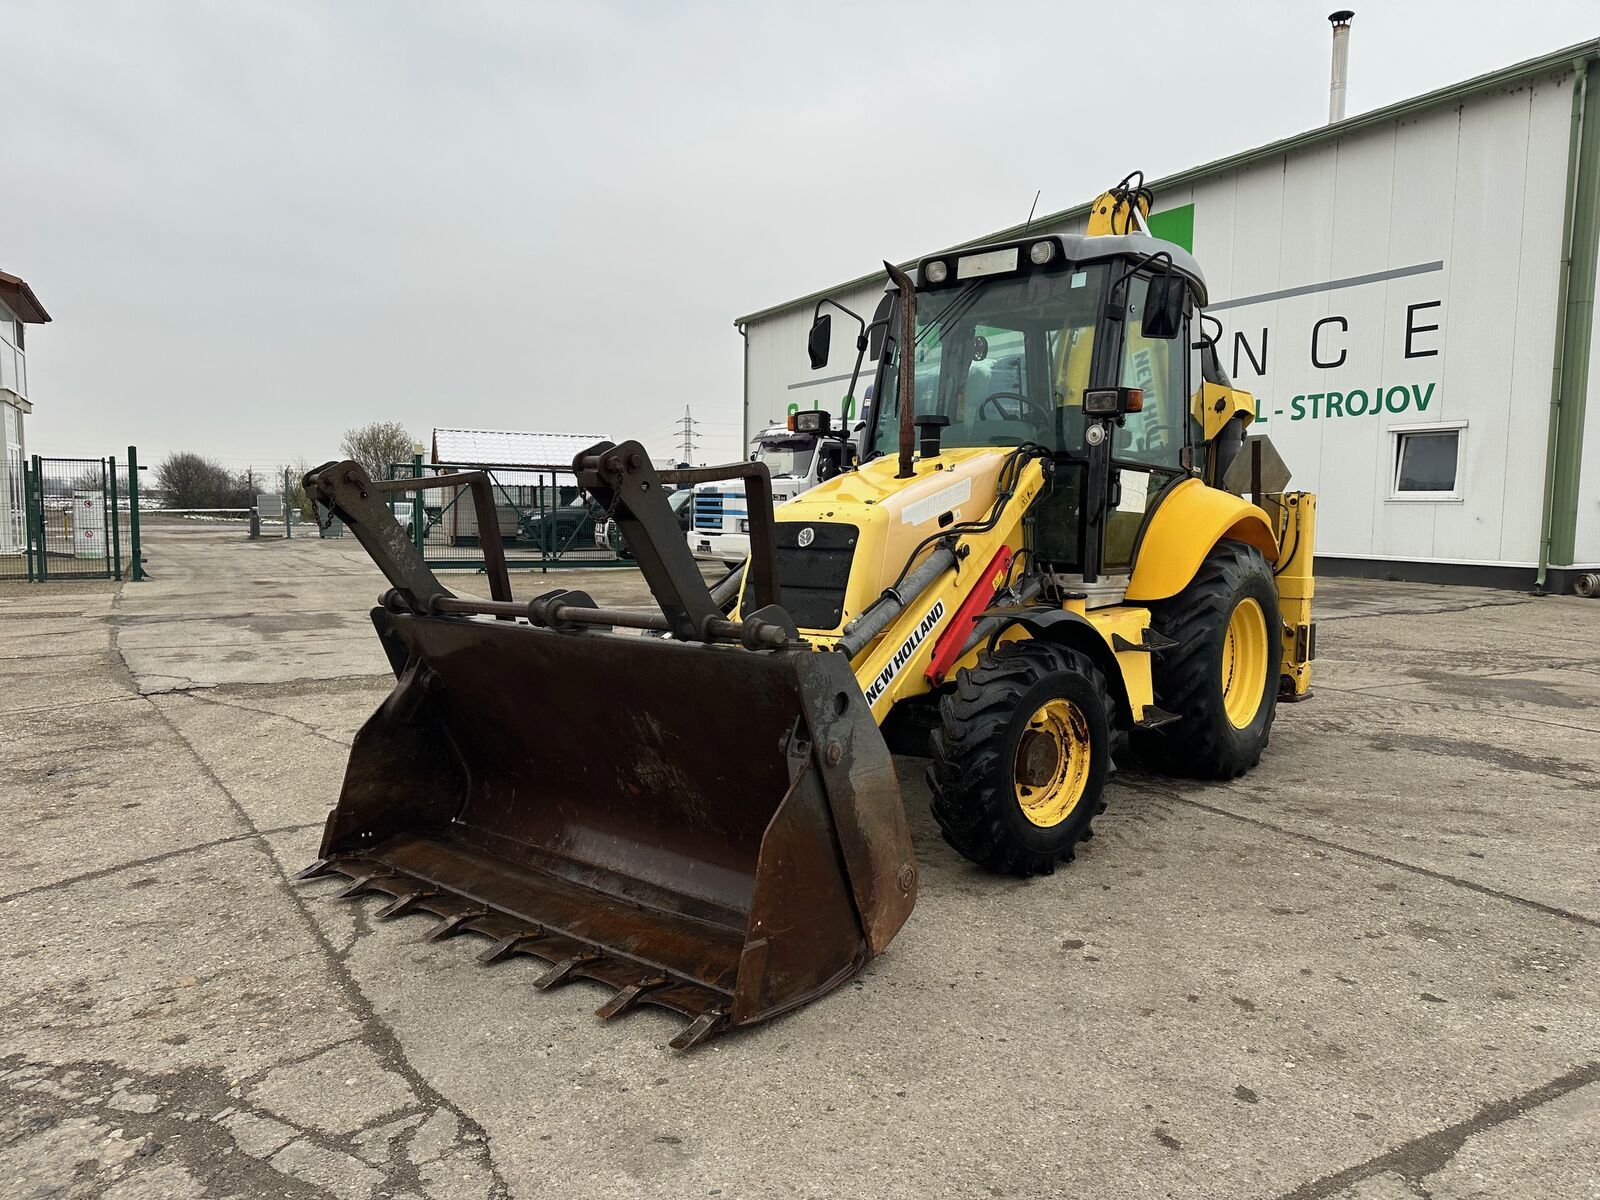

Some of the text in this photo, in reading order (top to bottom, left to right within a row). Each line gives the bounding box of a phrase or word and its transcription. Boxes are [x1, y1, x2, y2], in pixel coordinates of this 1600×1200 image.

[1291, 383, 1436, 421] STROJOV
[865, 601, 944, 706] NEW HOLLAND
